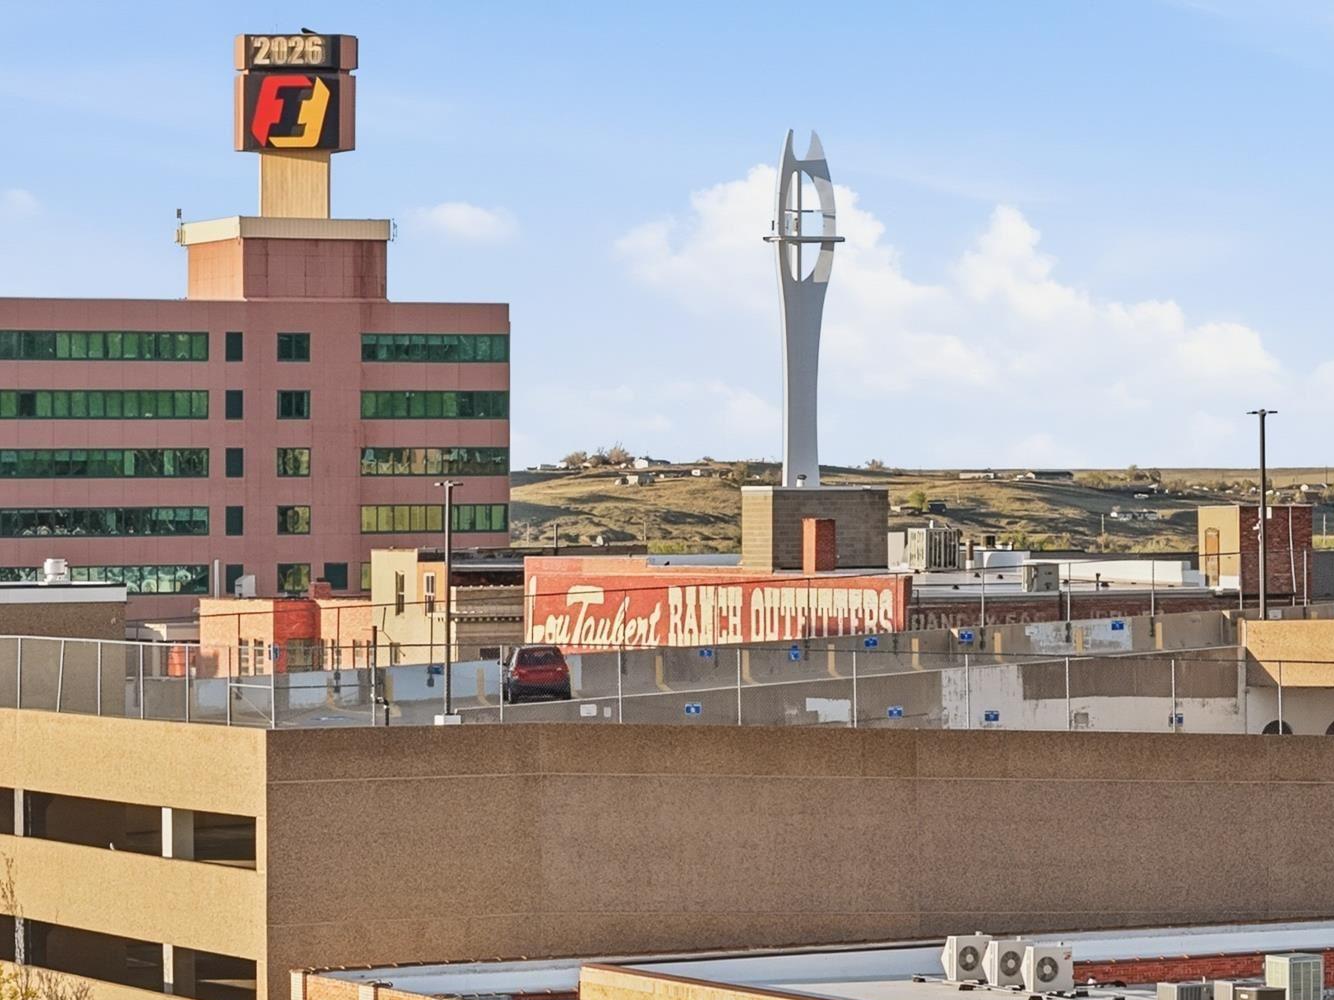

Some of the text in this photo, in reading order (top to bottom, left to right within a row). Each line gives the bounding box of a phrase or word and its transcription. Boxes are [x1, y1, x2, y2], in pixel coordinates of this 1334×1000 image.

[253, 36, 323, 65] 2026
[668, 585, 744, 646] RANCH
[750, 586, 894, 640] OUTFITTERS
